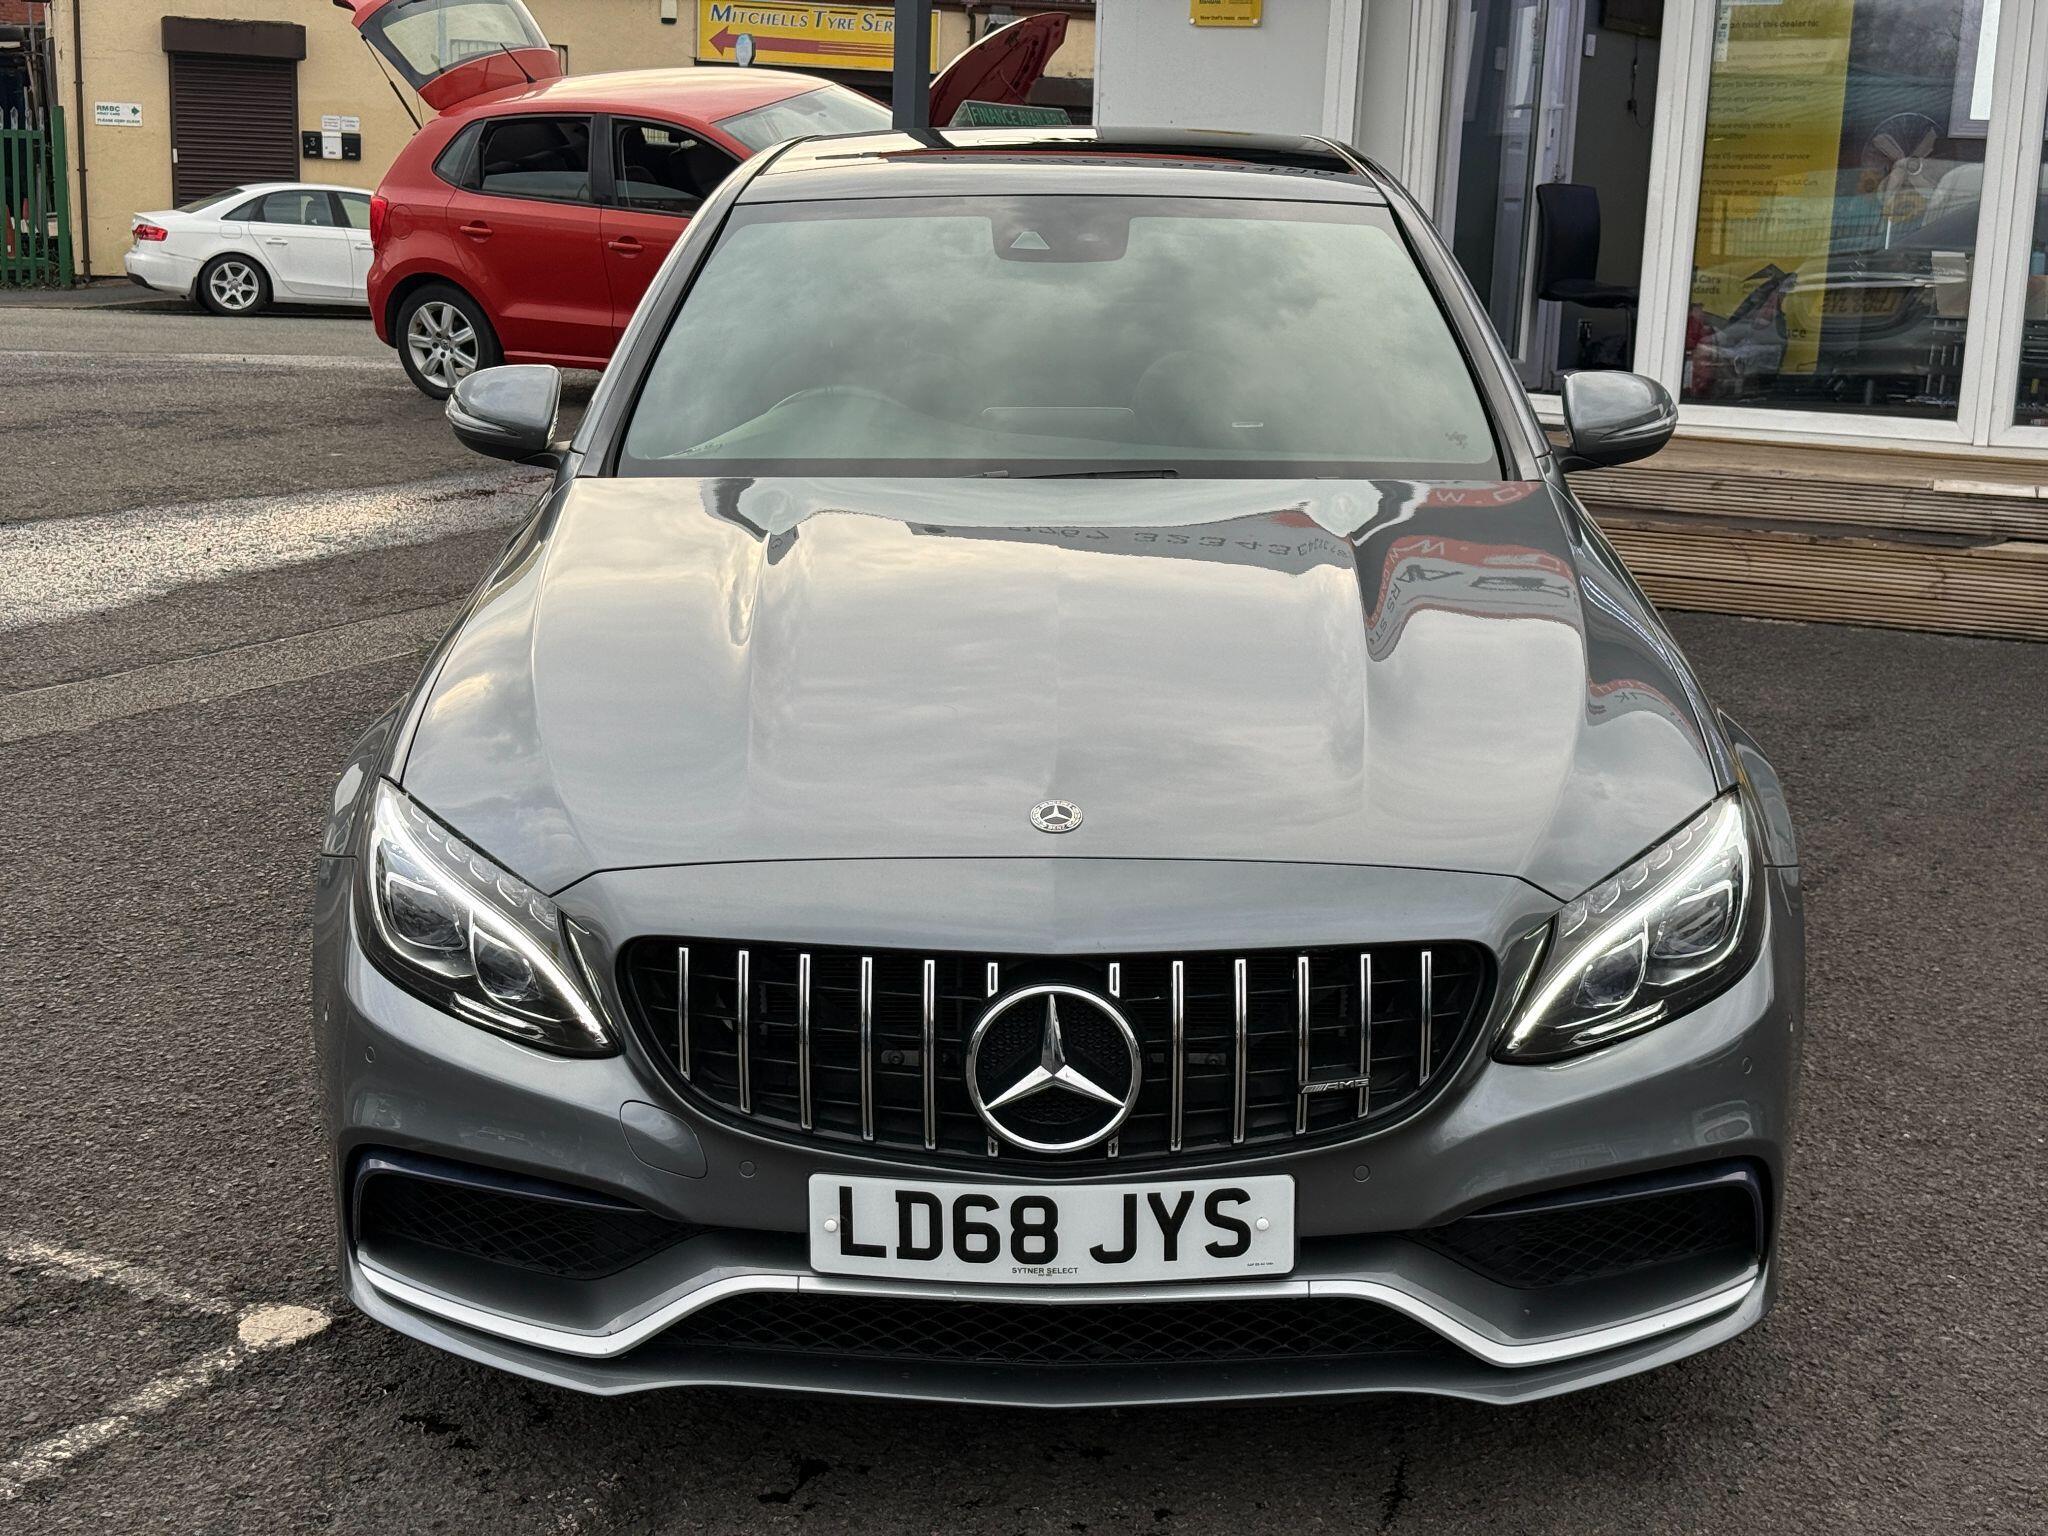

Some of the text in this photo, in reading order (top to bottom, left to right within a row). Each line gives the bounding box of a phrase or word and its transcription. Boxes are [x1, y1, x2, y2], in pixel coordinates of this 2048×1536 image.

[710, 4, 809, 27] MITCHELLS
[813, 10, 855, 30] TYRE
[970, 106, 1018, 125] FINANCE
[839, 1186, 1252, 1264] LD68 JYS
